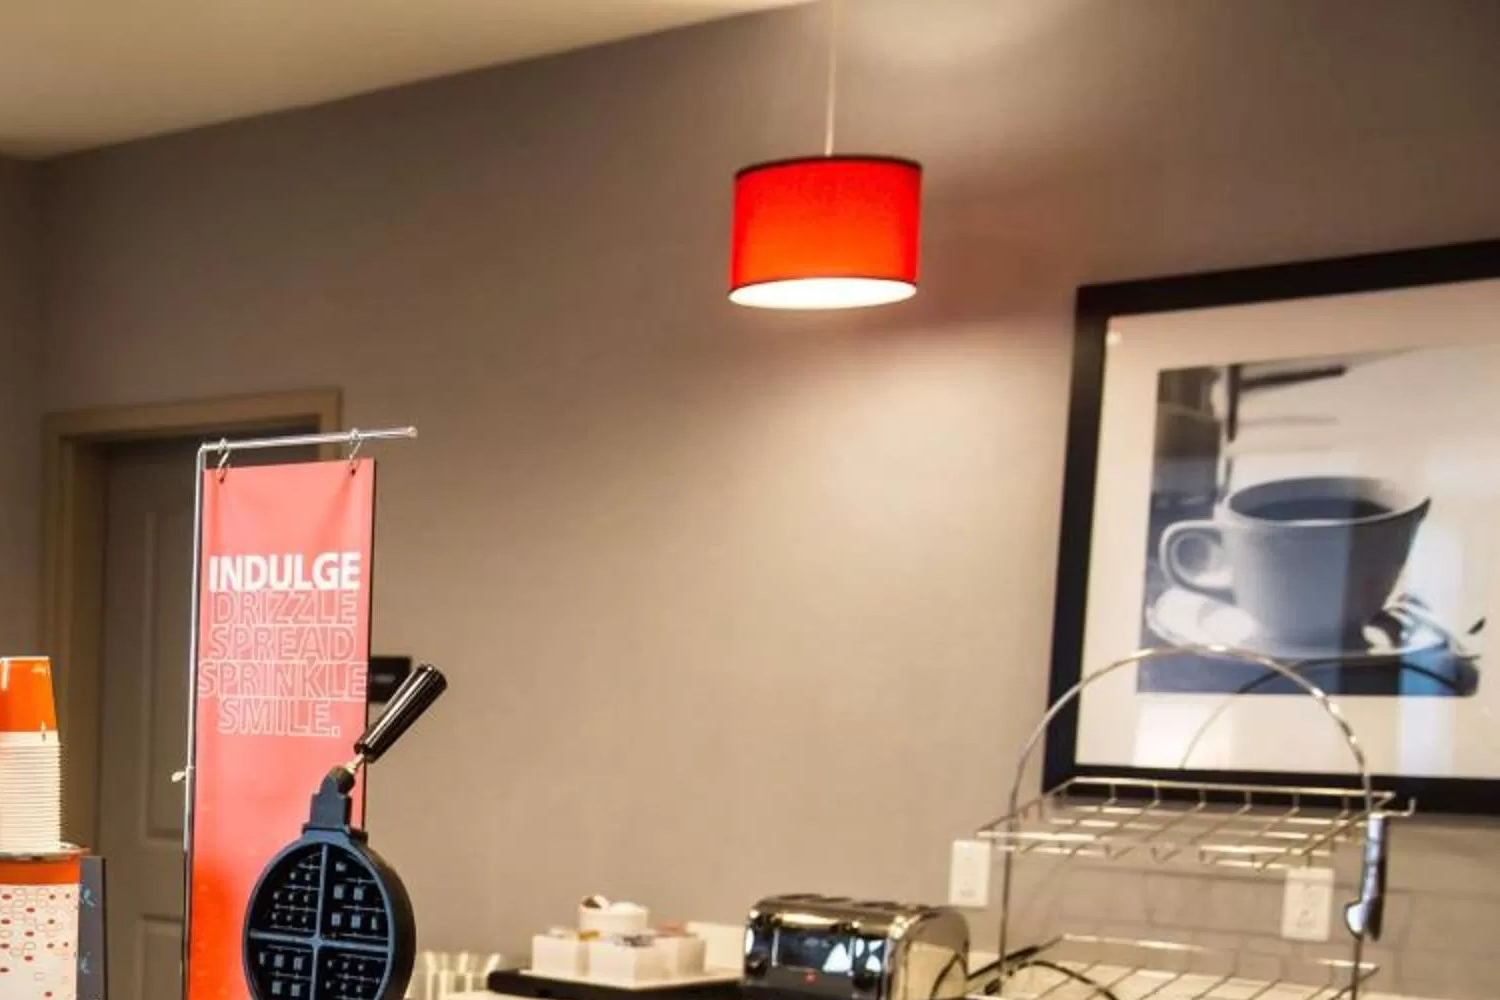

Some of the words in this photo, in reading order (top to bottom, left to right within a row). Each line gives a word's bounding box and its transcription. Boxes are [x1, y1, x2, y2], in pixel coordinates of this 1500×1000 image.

[208, 552, 362, 593] INDULGE
[211, 588, 358, 626] DRIZZLE
[209, 623, 357, 664] SPREAD
[197, 659, 369, 702] SPRINKLE
[217, 697, 341, 737] SMILE.
